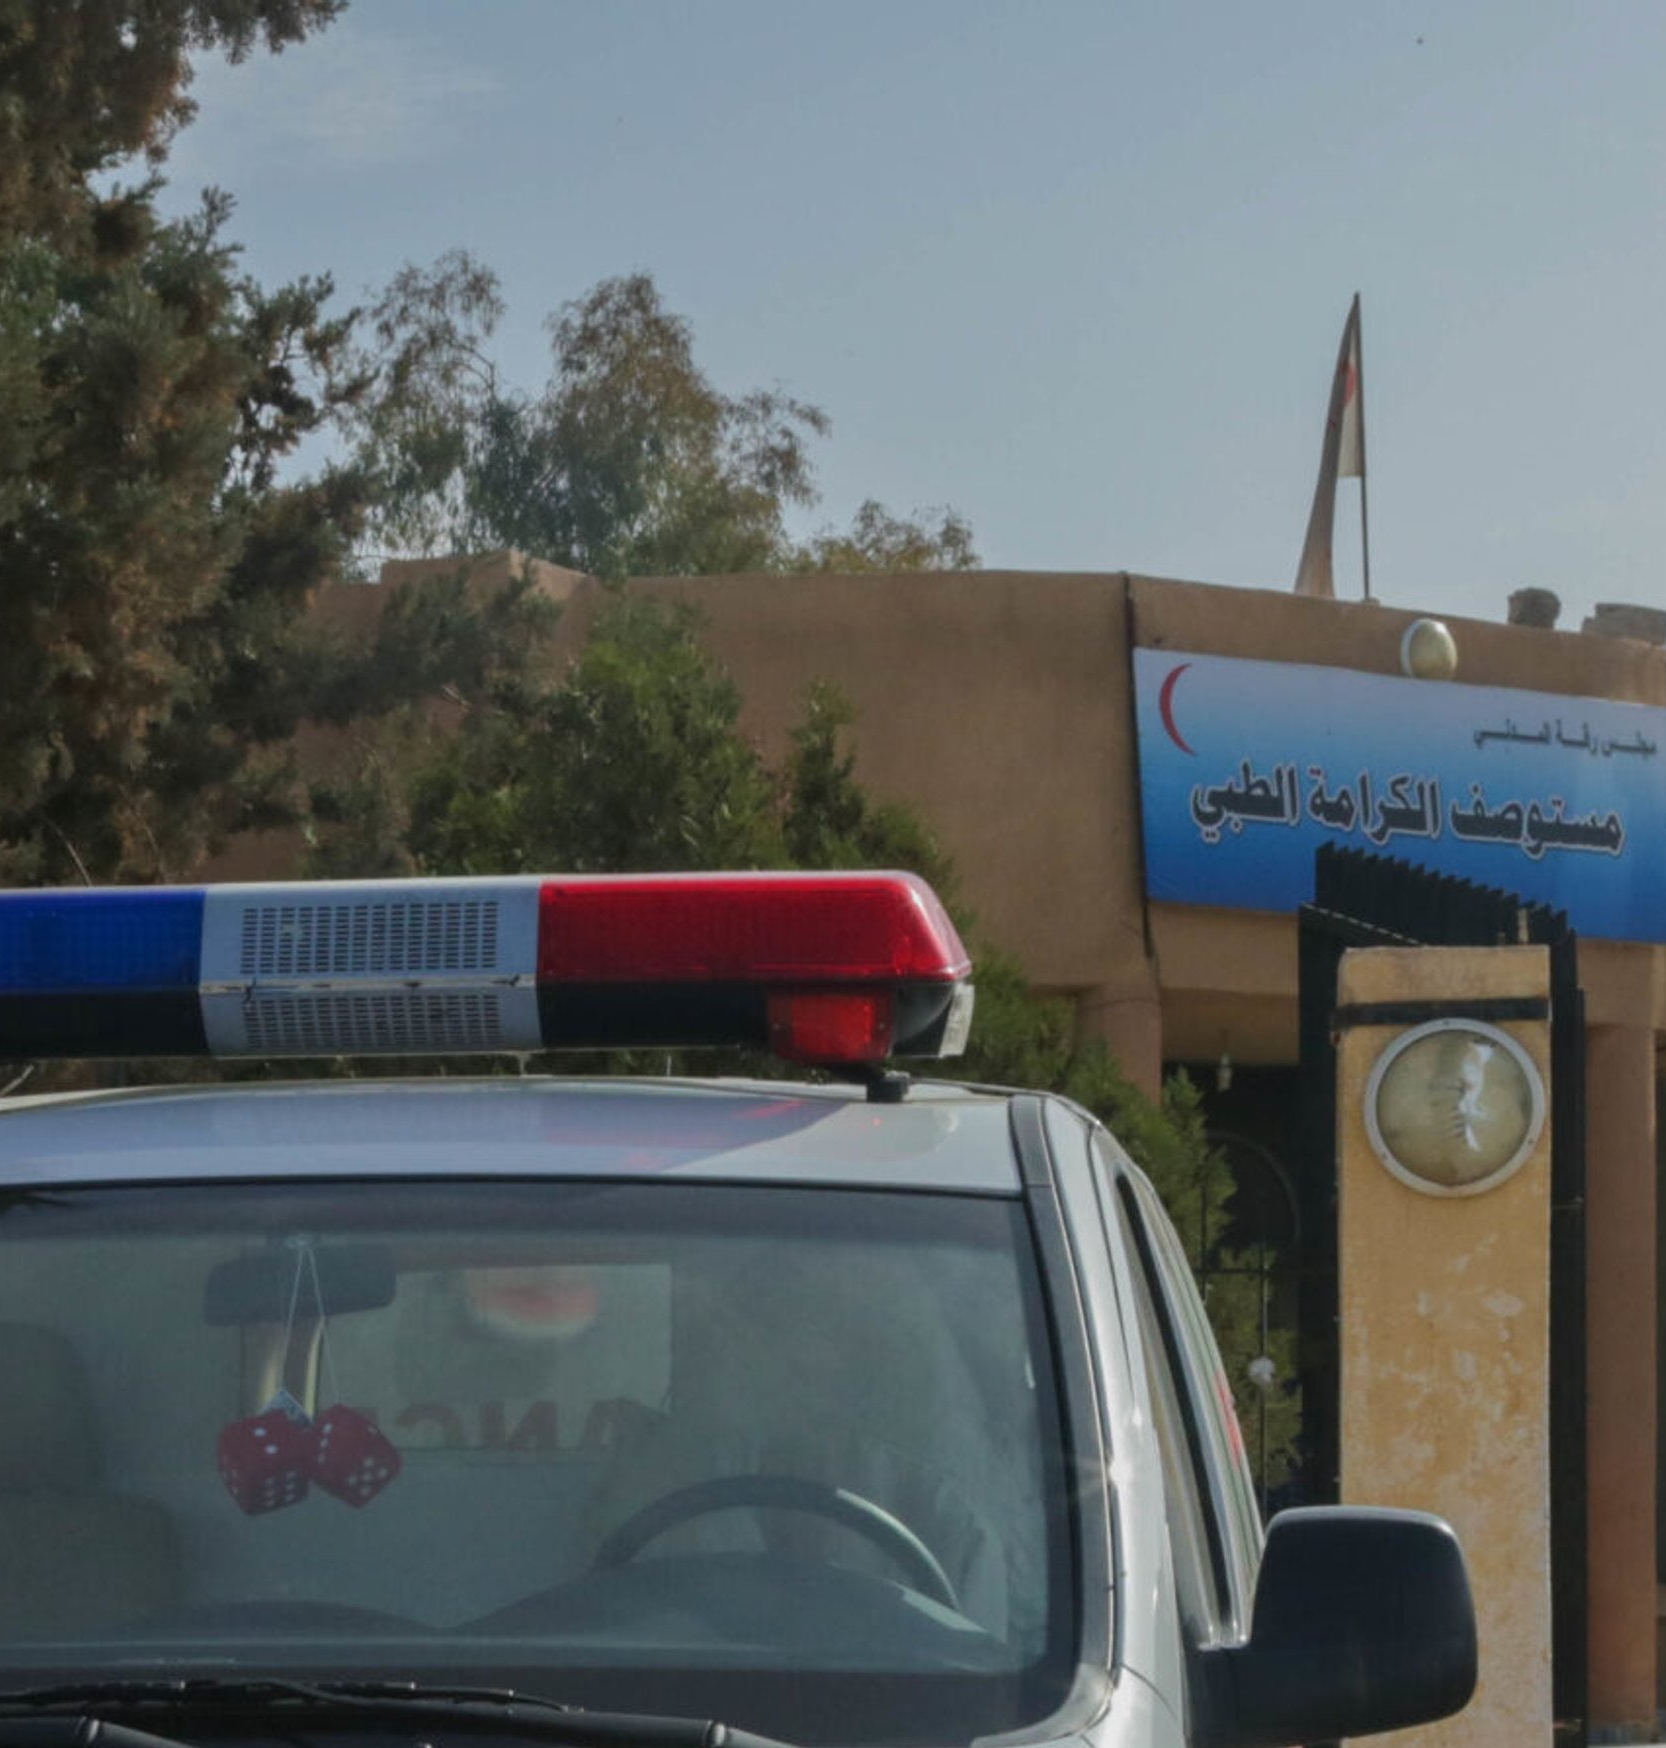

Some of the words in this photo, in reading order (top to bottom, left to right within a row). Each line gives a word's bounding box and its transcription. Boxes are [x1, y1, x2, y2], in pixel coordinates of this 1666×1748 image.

[1191, 759, 1299, 843] الطبي
[1307, 766, 1440, 845] الكرامة
[1450, 782, 1624, 858] مستوصف
